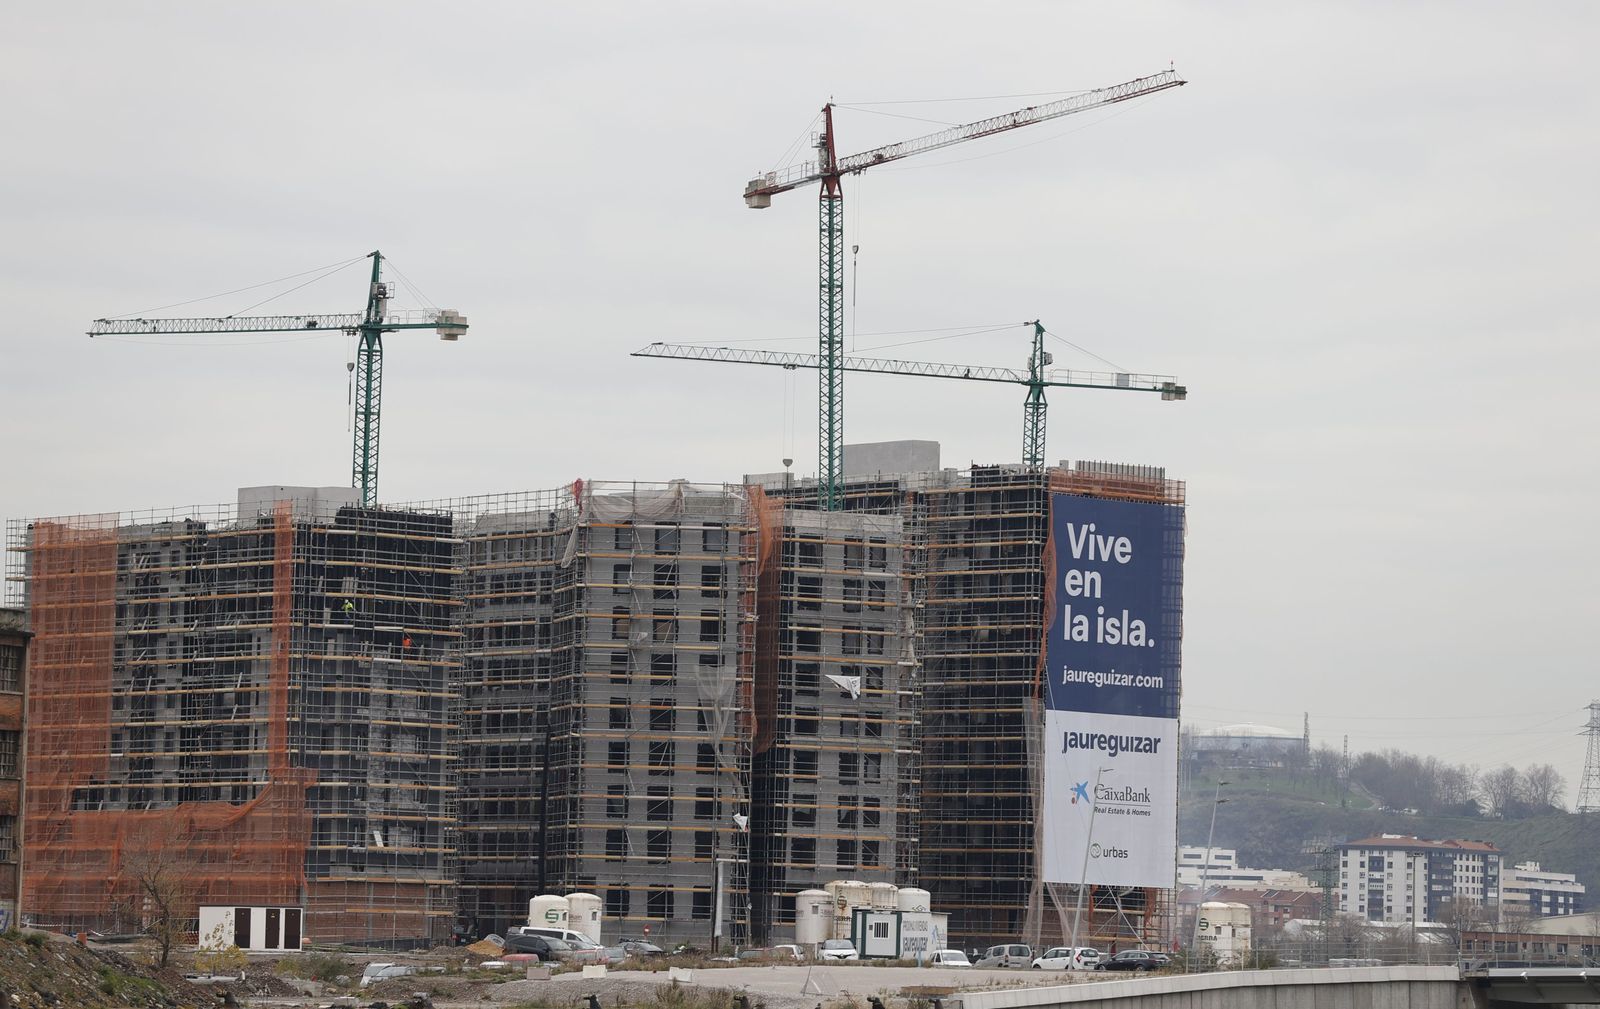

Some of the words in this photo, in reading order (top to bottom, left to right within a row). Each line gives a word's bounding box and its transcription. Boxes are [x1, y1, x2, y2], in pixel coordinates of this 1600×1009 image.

[1066, 522, 1132, 564] Vive
[1065, 569, 1102, 599] en
[1063, 604, 1089, 642] la
[1097, 605, 1155, 648] isla.
[1062, 665, 1163, 689] jaureguizar.com
[1062, 731, 1161, 758] jaureguizar
[1094, 783, 1151, 803] CaixaBank
[1094, 806, 1107, 814] Real
[1107, 807, 1125, 815] Estate
[1126, 807, 1131, 815] &
[1131, 807, 1151, 816] Homes
[1103, 846, 1129, 859] urbas
